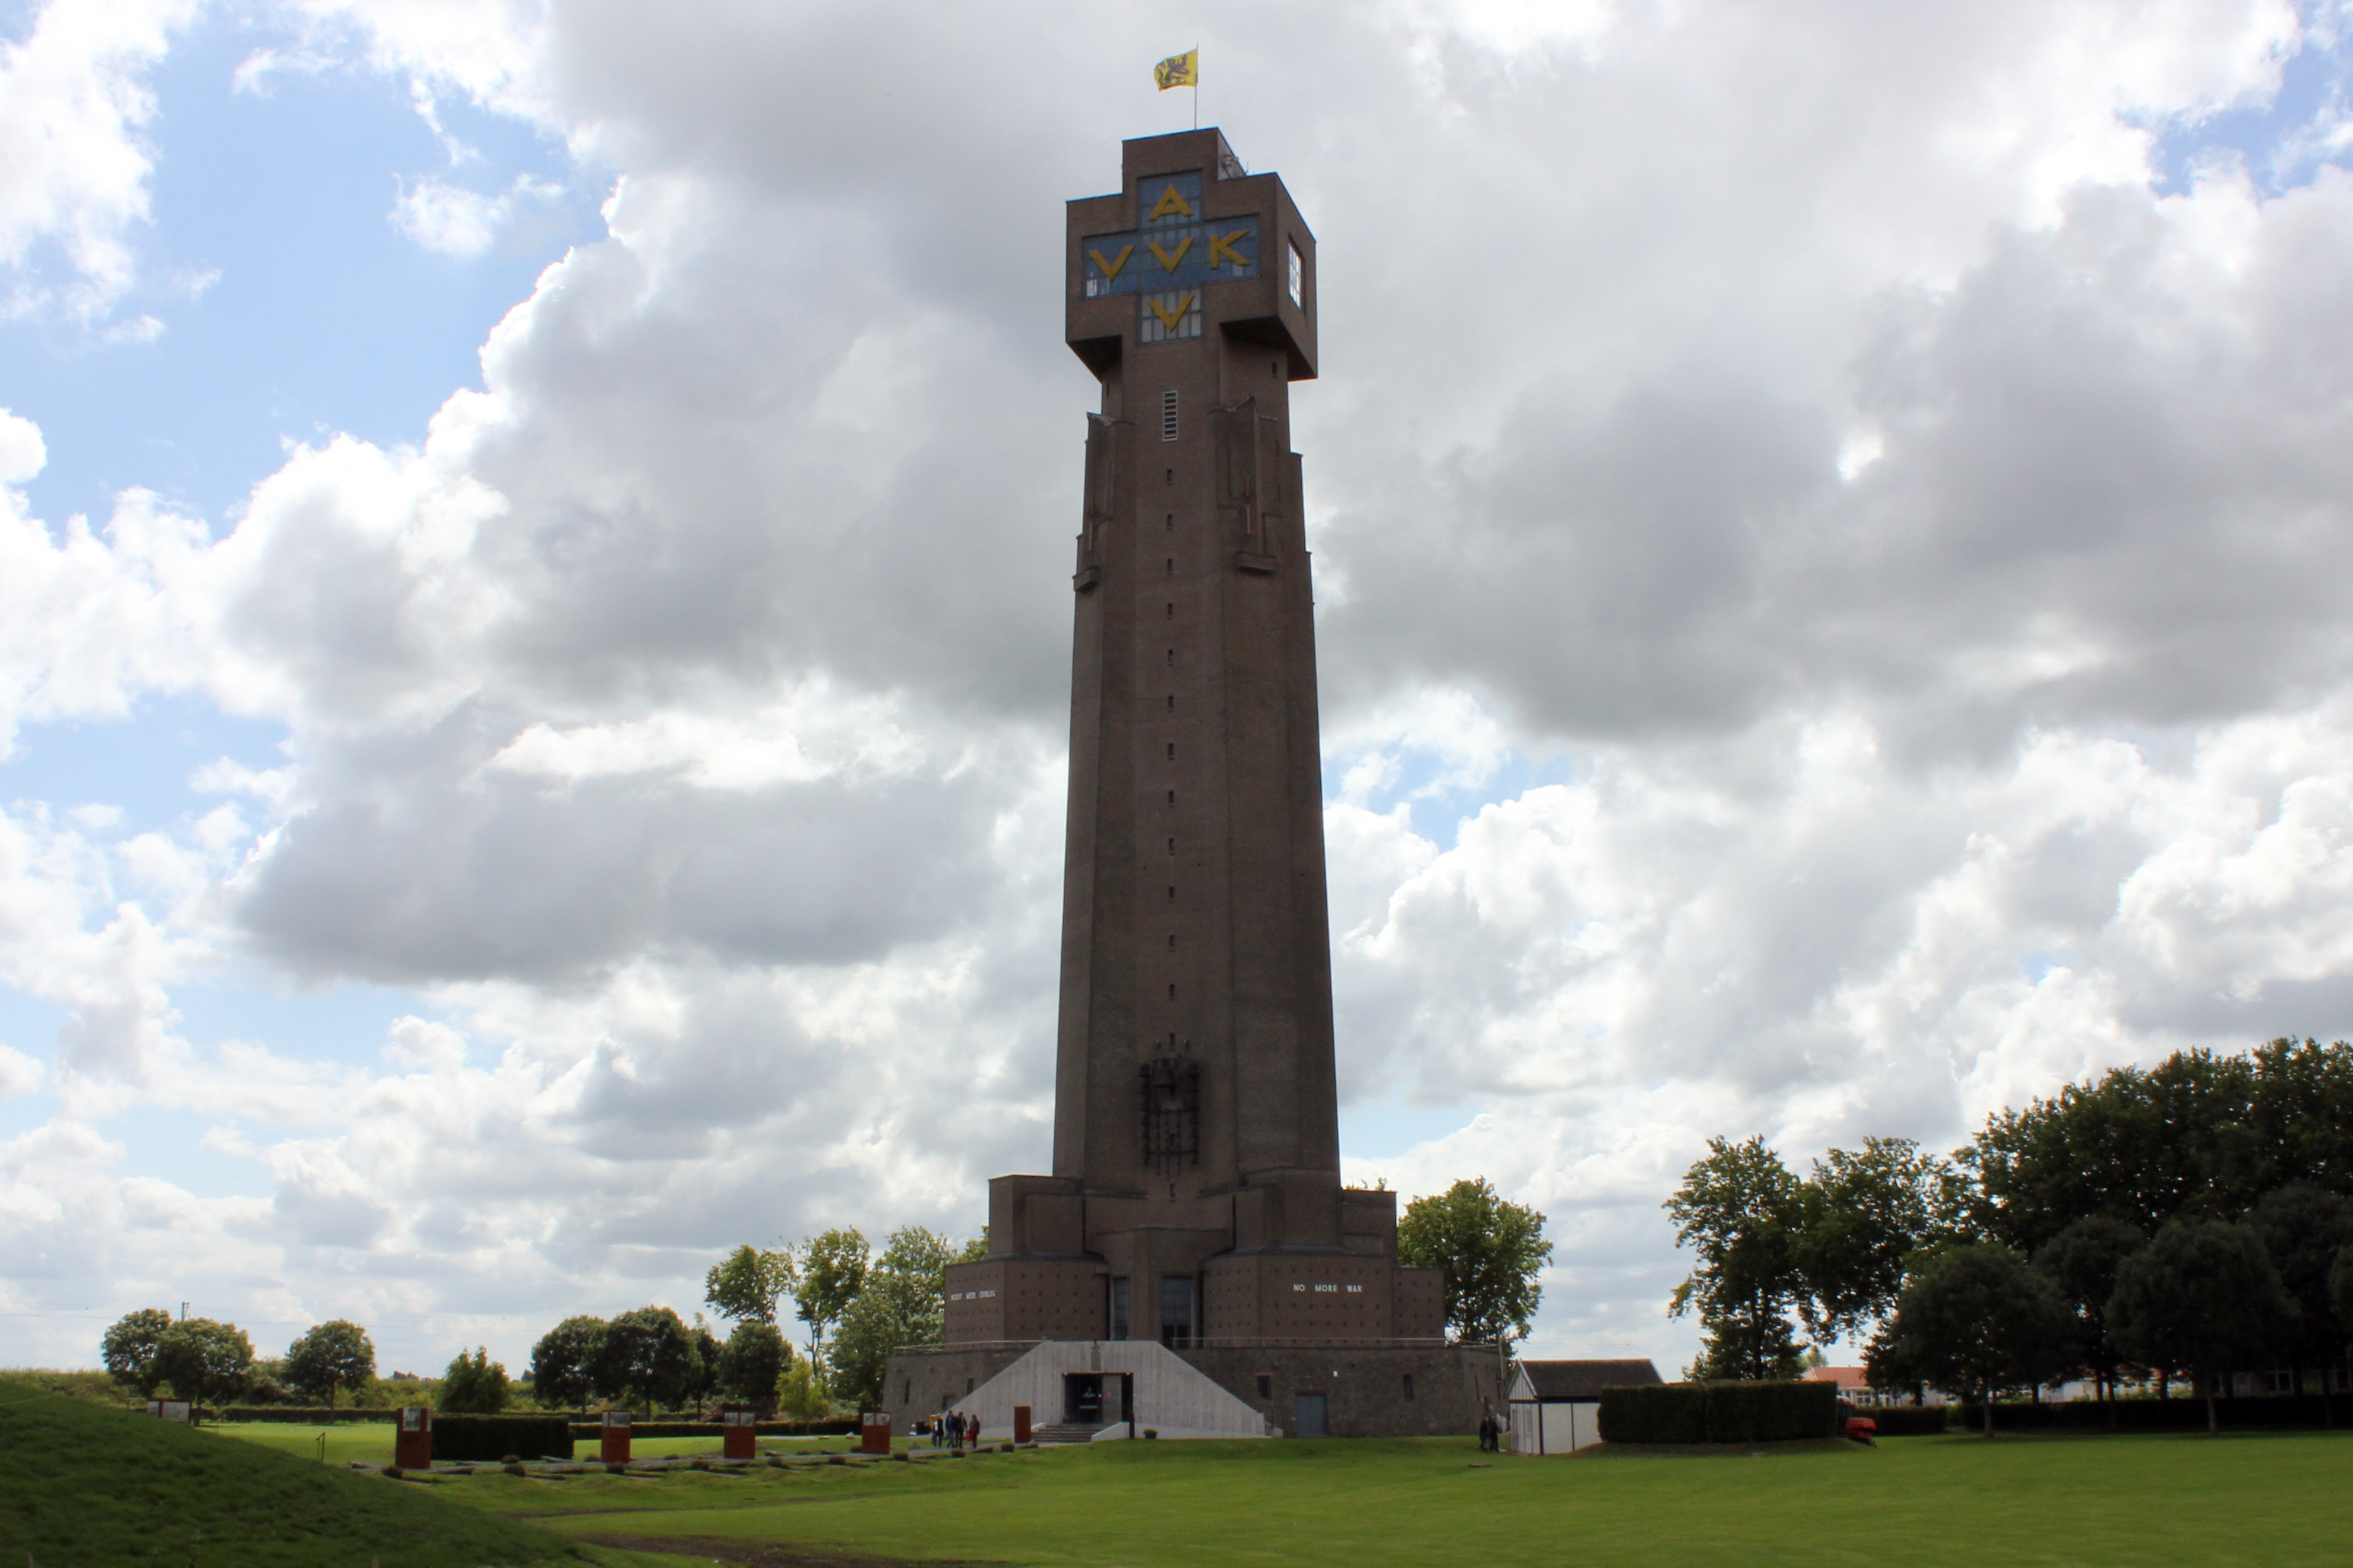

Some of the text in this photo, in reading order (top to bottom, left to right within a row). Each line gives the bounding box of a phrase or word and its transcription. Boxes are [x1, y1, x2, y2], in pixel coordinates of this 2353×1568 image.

[1148, 184, 1194, 221] A
[1148, 294, 1195, 333] V
[1293, 1284, 1362, 1293] NO MORE WAR
